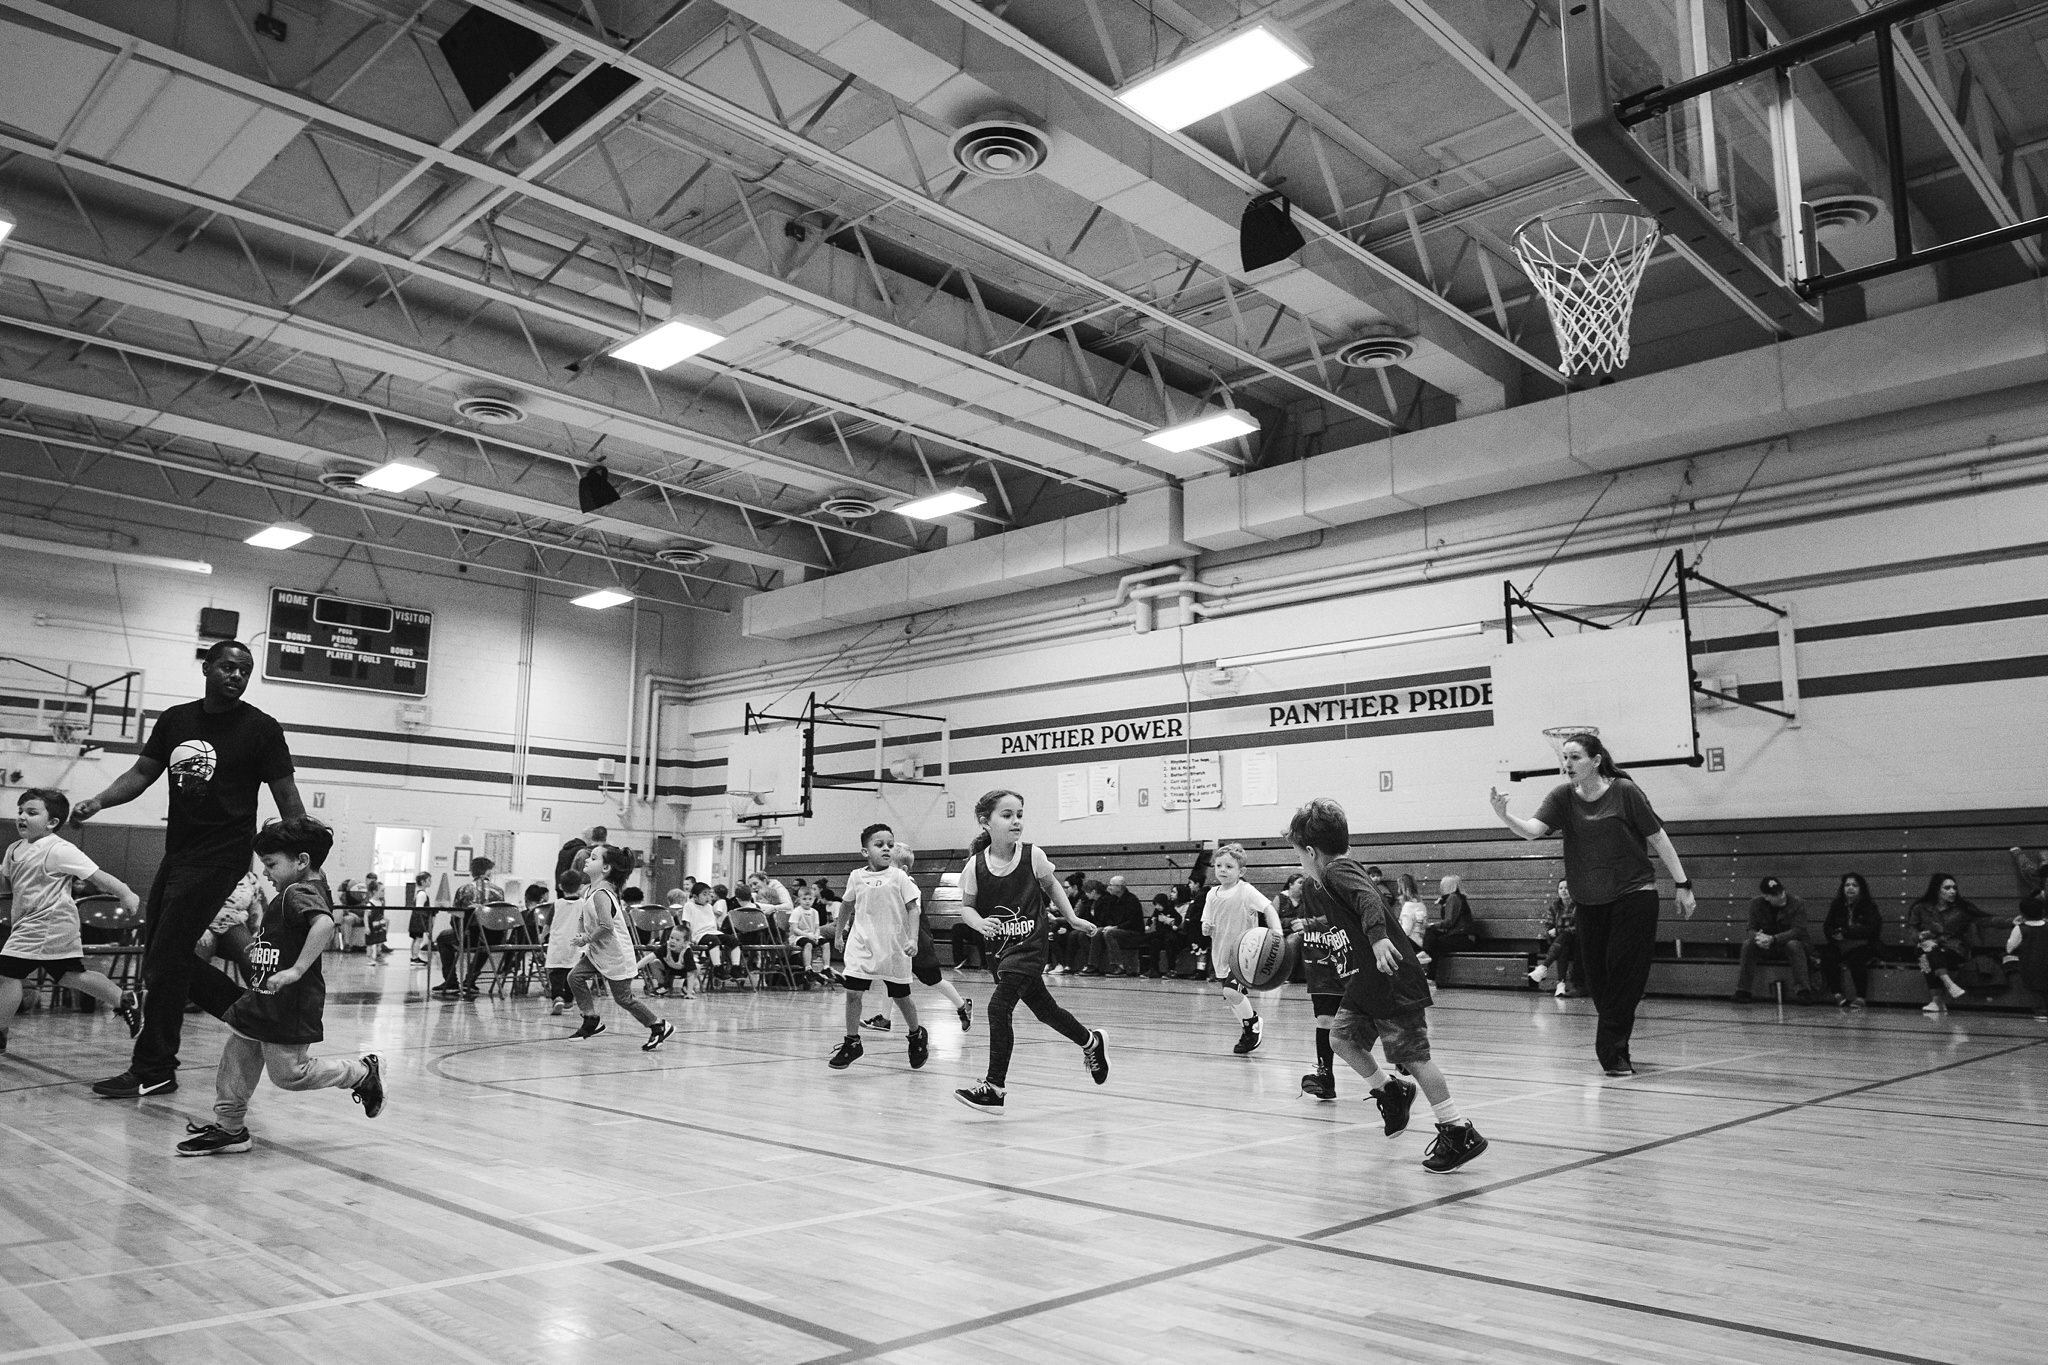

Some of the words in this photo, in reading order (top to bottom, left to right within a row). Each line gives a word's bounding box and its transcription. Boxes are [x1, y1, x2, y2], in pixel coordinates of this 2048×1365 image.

[278, 592, 309, 606] HOME
[395, 610, 430, 625] VISITOR
[286, 631, 312, 643] BONUS
[331, 634, 358, 646] PERIOD
[280, 644, 306, 655] FOULS
[326, 650, 353, 661] PLAYER
[358, 654, 381, 664] FOULS
[390, 646, 414, 656] BONUS
[394, 659, 417, 669] FOULS
[1269, 694, 1399, 727] PANTHER
[1408, 682, 1493, 713] PRIDE
[1001, 728, 1095, 754] PANTHER
[1100, 718, 1183, 744] POWER
[1708, 749, 1723, 771] E
[1381, 772, 1391, 790] D
[314, 792, 325, 808] Y
[1139, 790, 1148, 806] C
[542, 808, 551, 821] Z
[999, 920, 1035, 937] HARBOR
[1262, 933, 1281, 975] SPALDING
